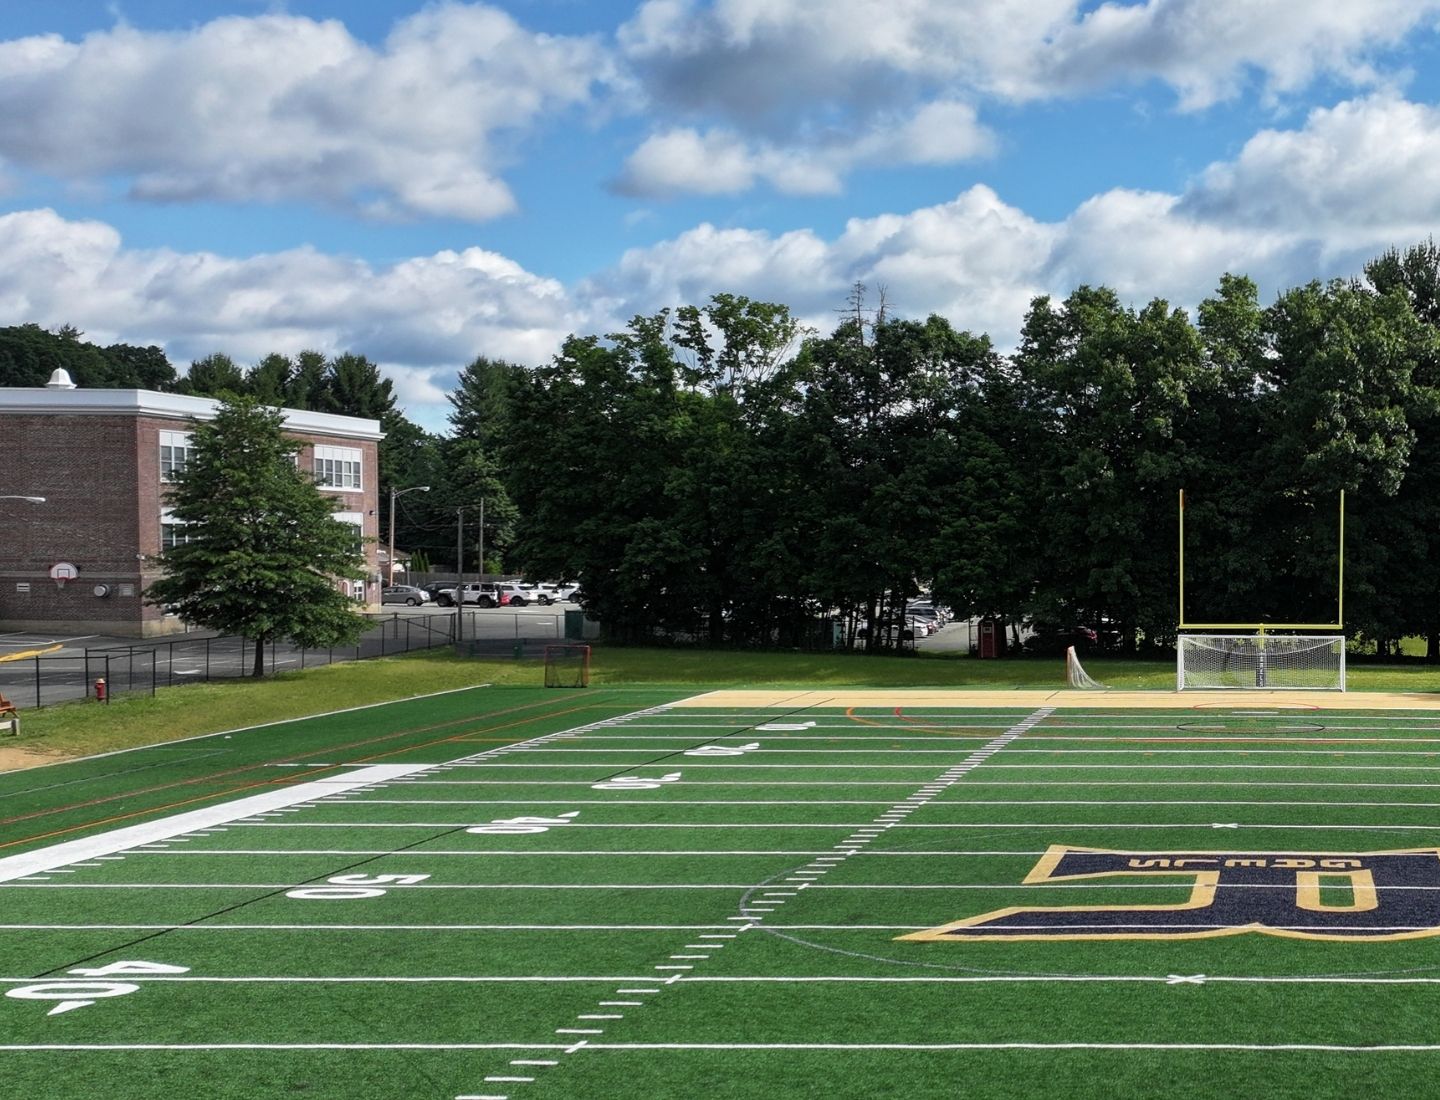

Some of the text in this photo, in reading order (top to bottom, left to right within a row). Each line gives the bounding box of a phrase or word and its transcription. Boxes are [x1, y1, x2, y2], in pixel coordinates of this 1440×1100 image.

[591, 776, 681, 789] 30
[466, 816, 570, 834] 40
[285, 874, 431, 899] 50
[4, 960, 191, 999] 40
